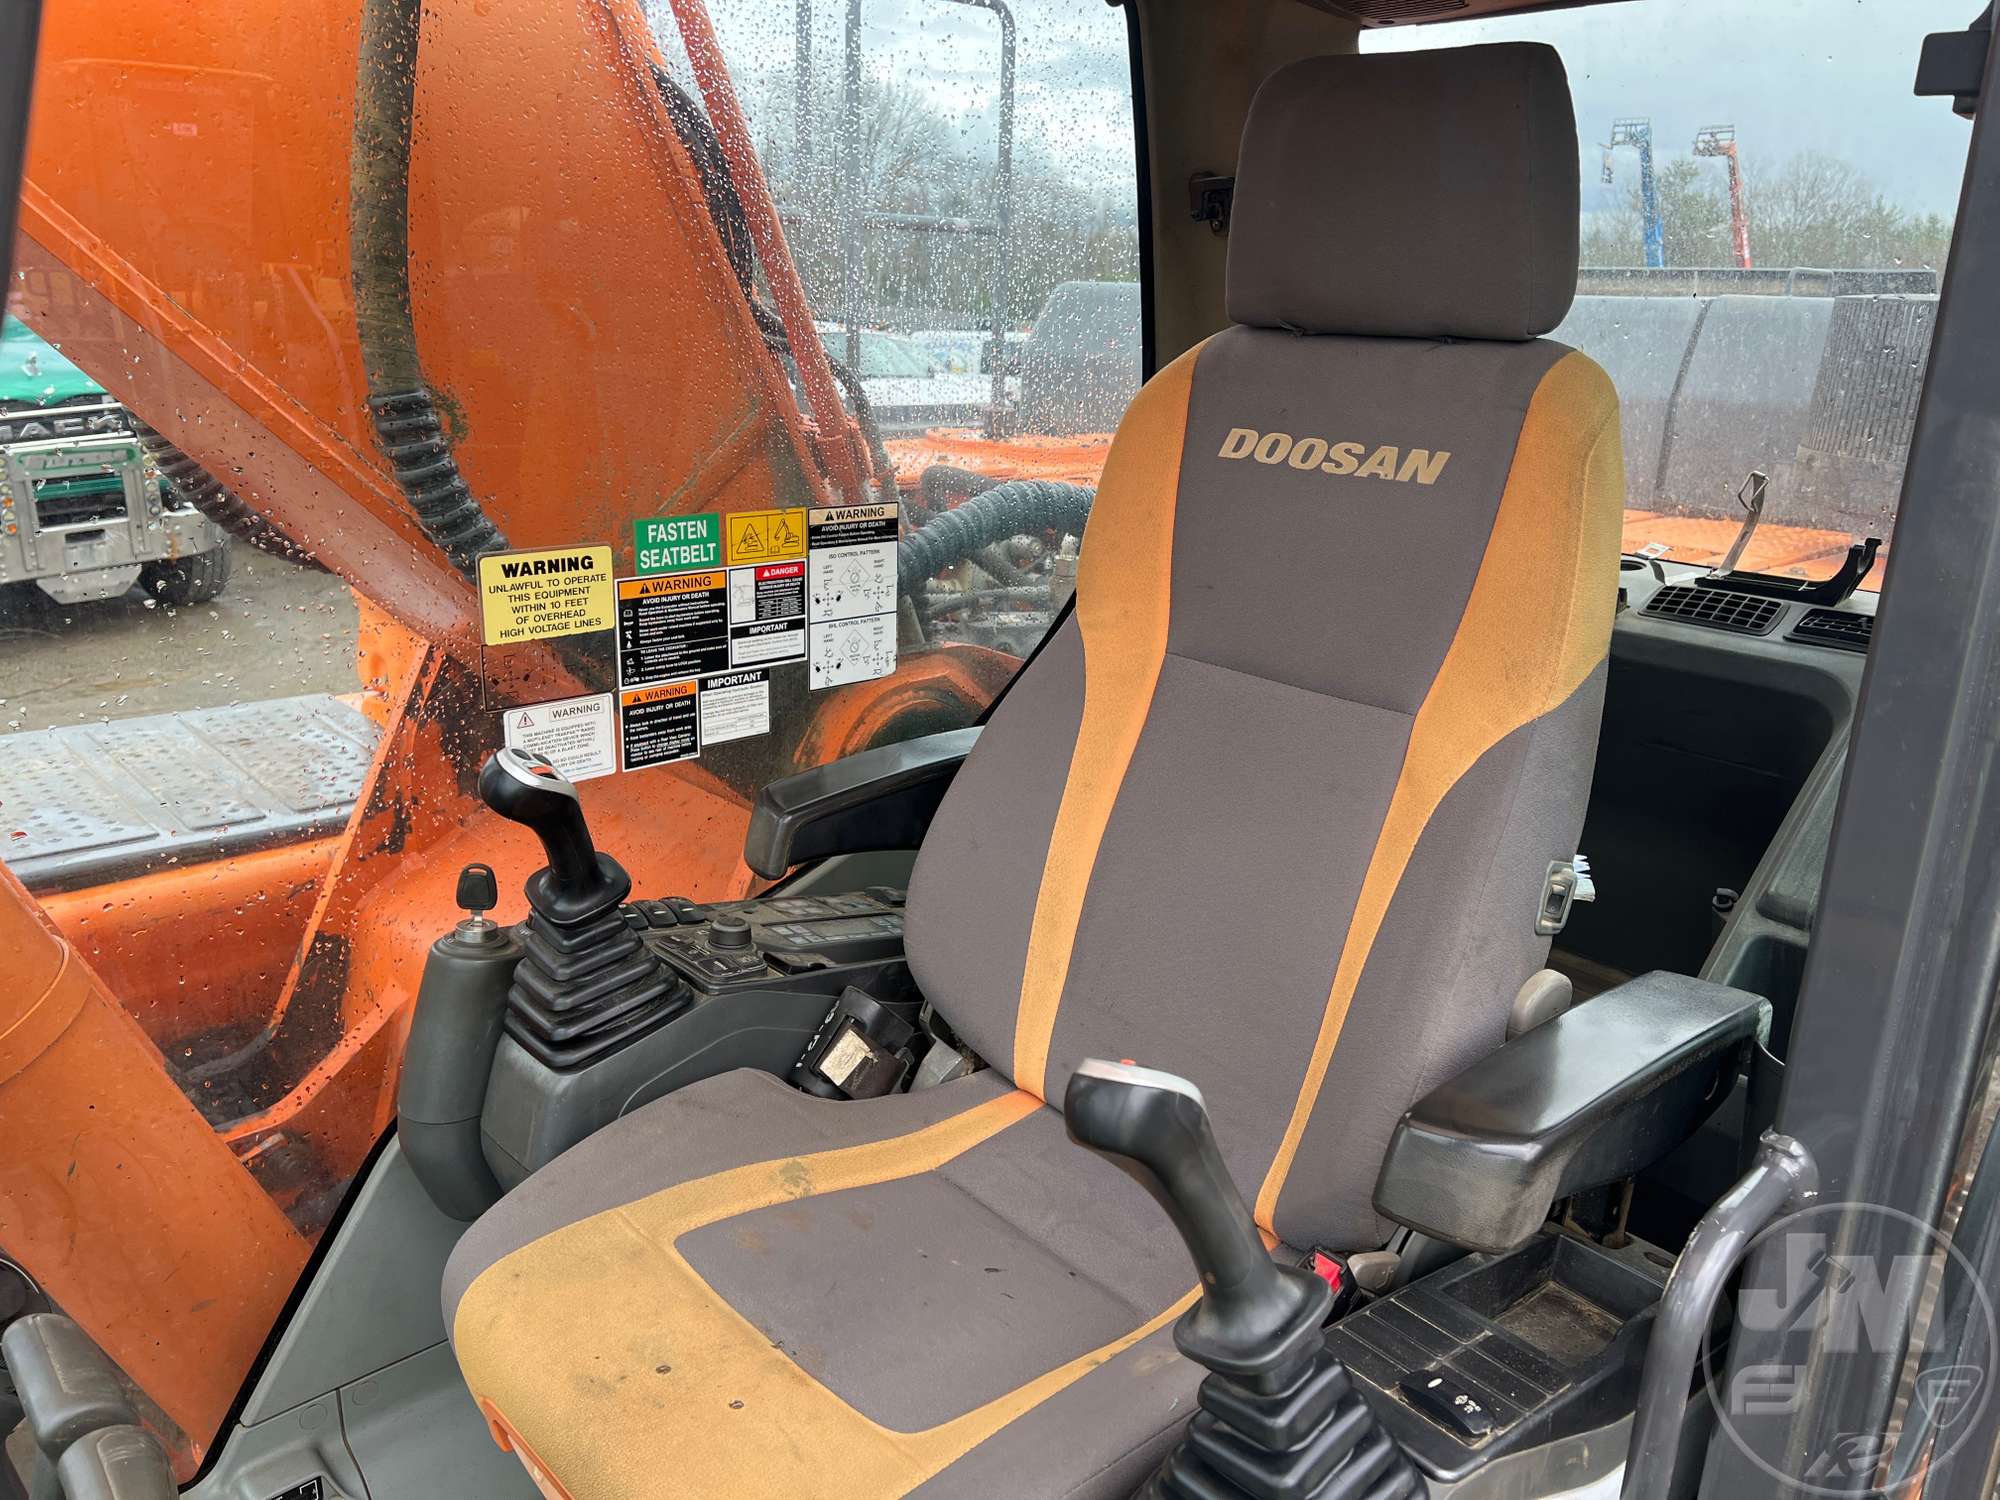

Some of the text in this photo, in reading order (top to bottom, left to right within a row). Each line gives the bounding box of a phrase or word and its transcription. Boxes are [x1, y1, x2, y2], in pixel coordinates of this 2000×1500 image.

[1217, 428, 1451, 485] DOOSAN
[836, 507, 885, 520] WARNING
[647, 520, 708, 543] FASTEN
[640, 543, 716, 569] SEATBELT
[501, 556, 594, 578] WARNING
[770, 566, 799, 576] DANGER
[488, 573, 607, 594] UNLAWFUL TO OPERATE
[652, 576, 712, 593] WARNING
[508, 586, 591, 603] THIS EQUIPMENT
[642, 597, 661, 606] AVOID
[660, 594, 681, 603] INJURY
[691, 591, 710, 600] DEATH
[512, 597, 589, 614] WITHIN 10 FEET
[516, 609, 586, 626] OF OVERHEAD
[500, 617, 602, 639] HIGH VOLTAGE LINES
[748, 622, 788, 635] IMPORTANT
[707, 671, 762, 689] IMPORTANT
[645, 686, 688, 701] WARNING
[552, 703, 600, 719] WARNING
[646, 705, 664, 713] INJURY
[675, 700, 691, 708] DEATH
